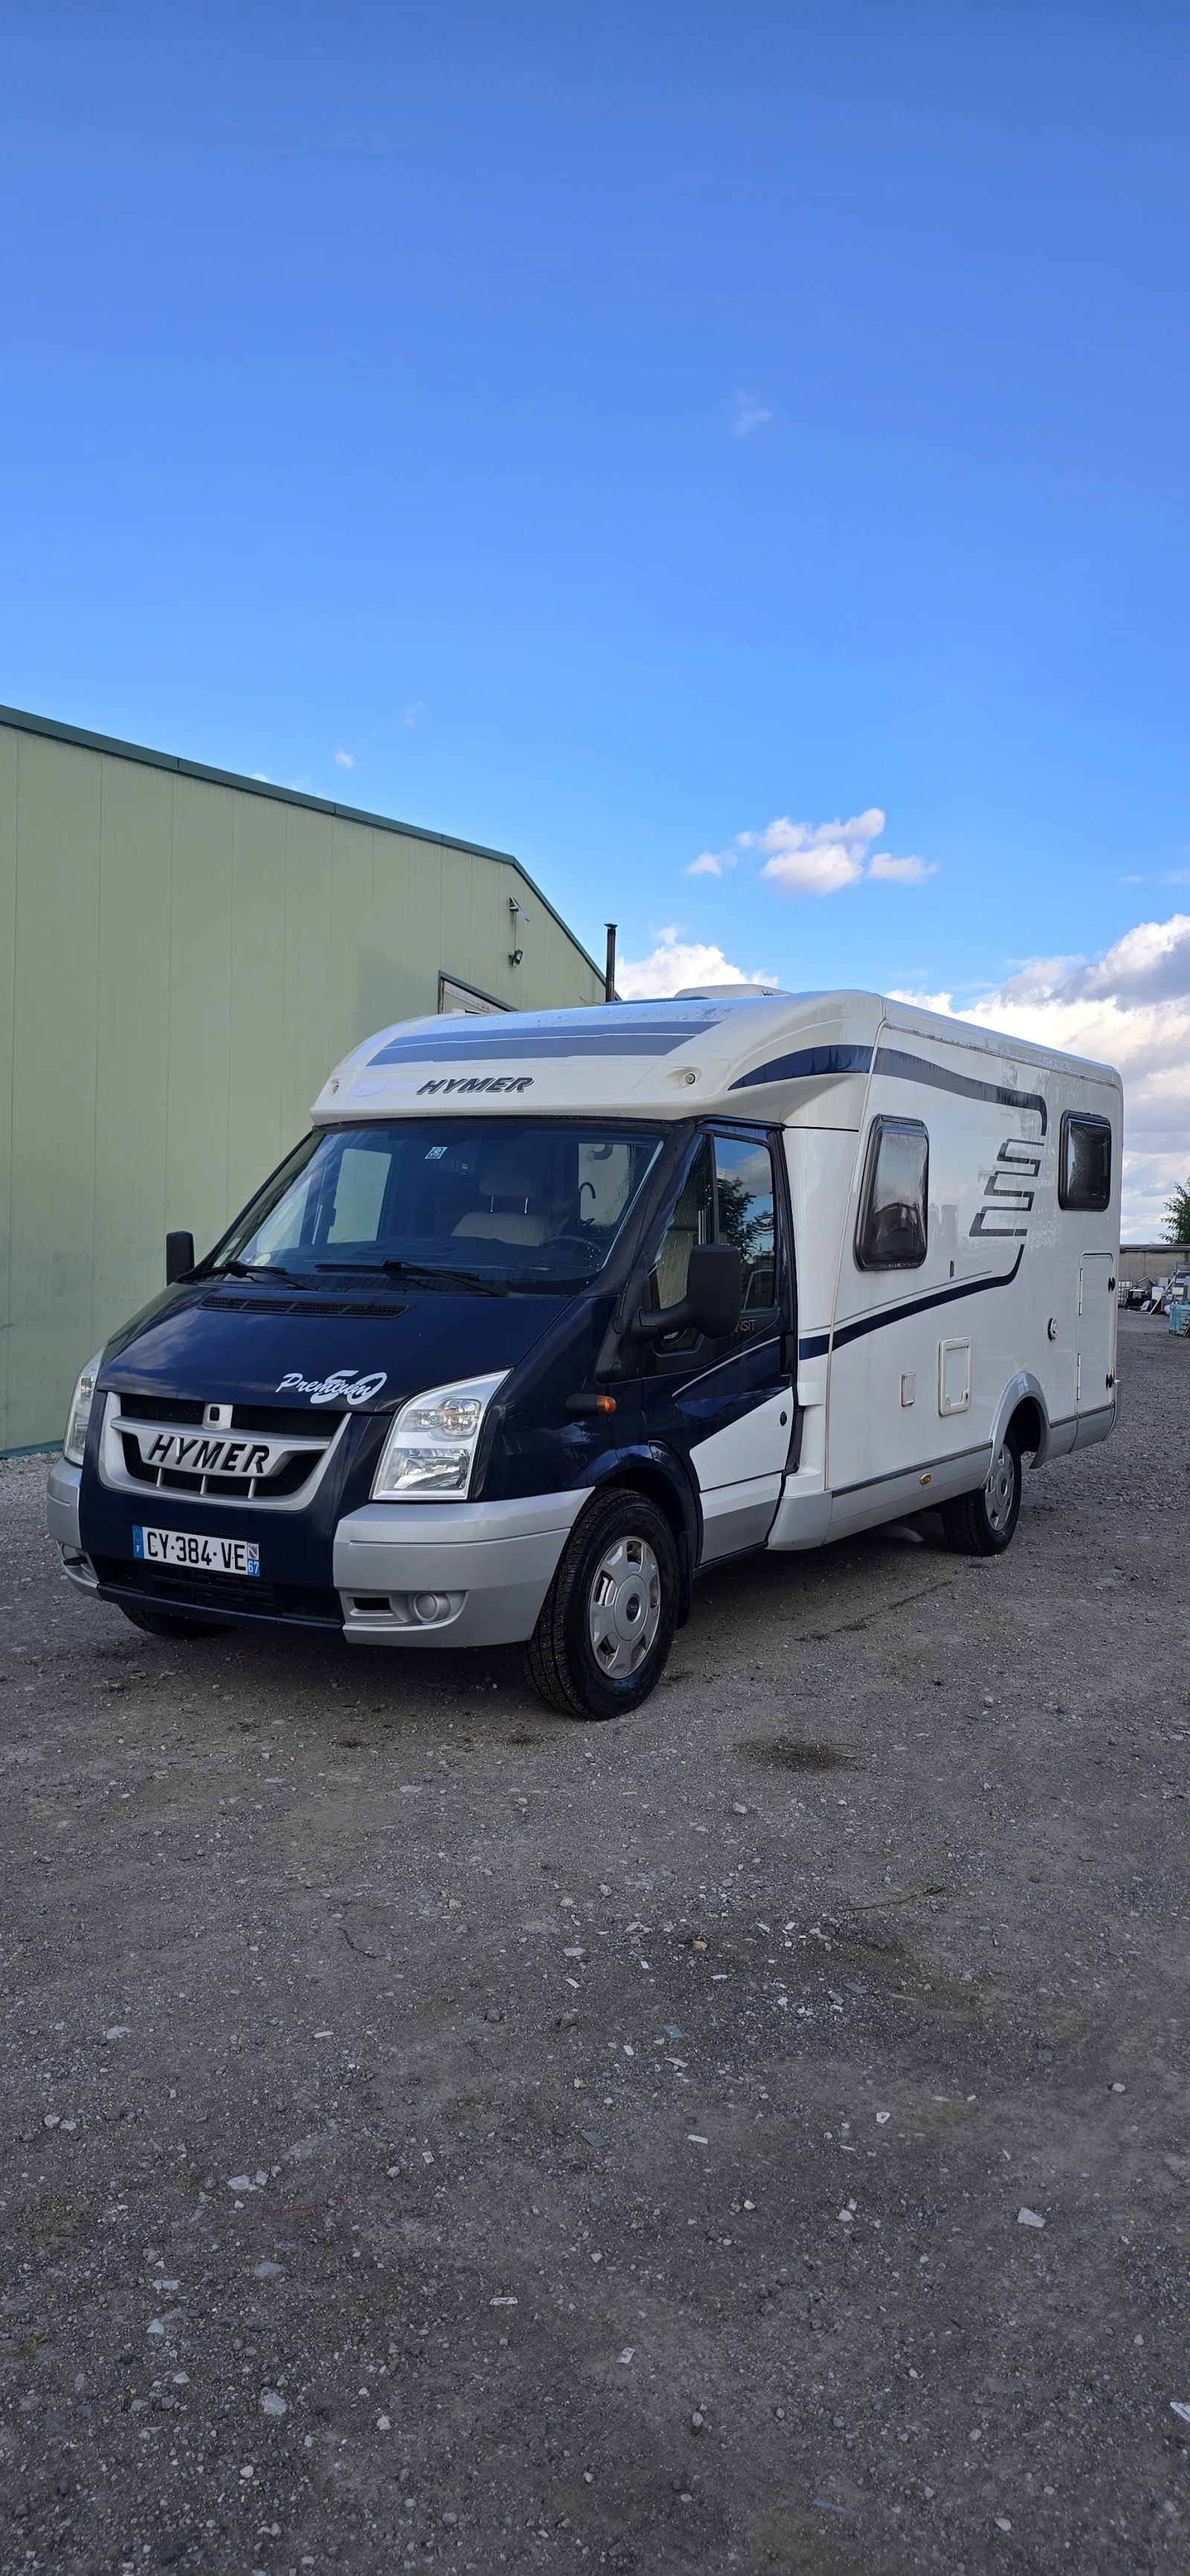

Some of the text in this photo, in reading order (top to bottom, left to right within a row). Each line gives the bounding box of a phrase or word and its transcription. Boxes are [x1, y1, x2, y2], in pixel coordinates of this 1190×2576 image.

[416, 1076, 535, 1095] HYMER
[276, 1373, 371, 1396] Premium
[146, 1433, 270, 1474] HYMER
[136, 1544, 141, 1553] F
[248, 1560, 260, 1574] 67
